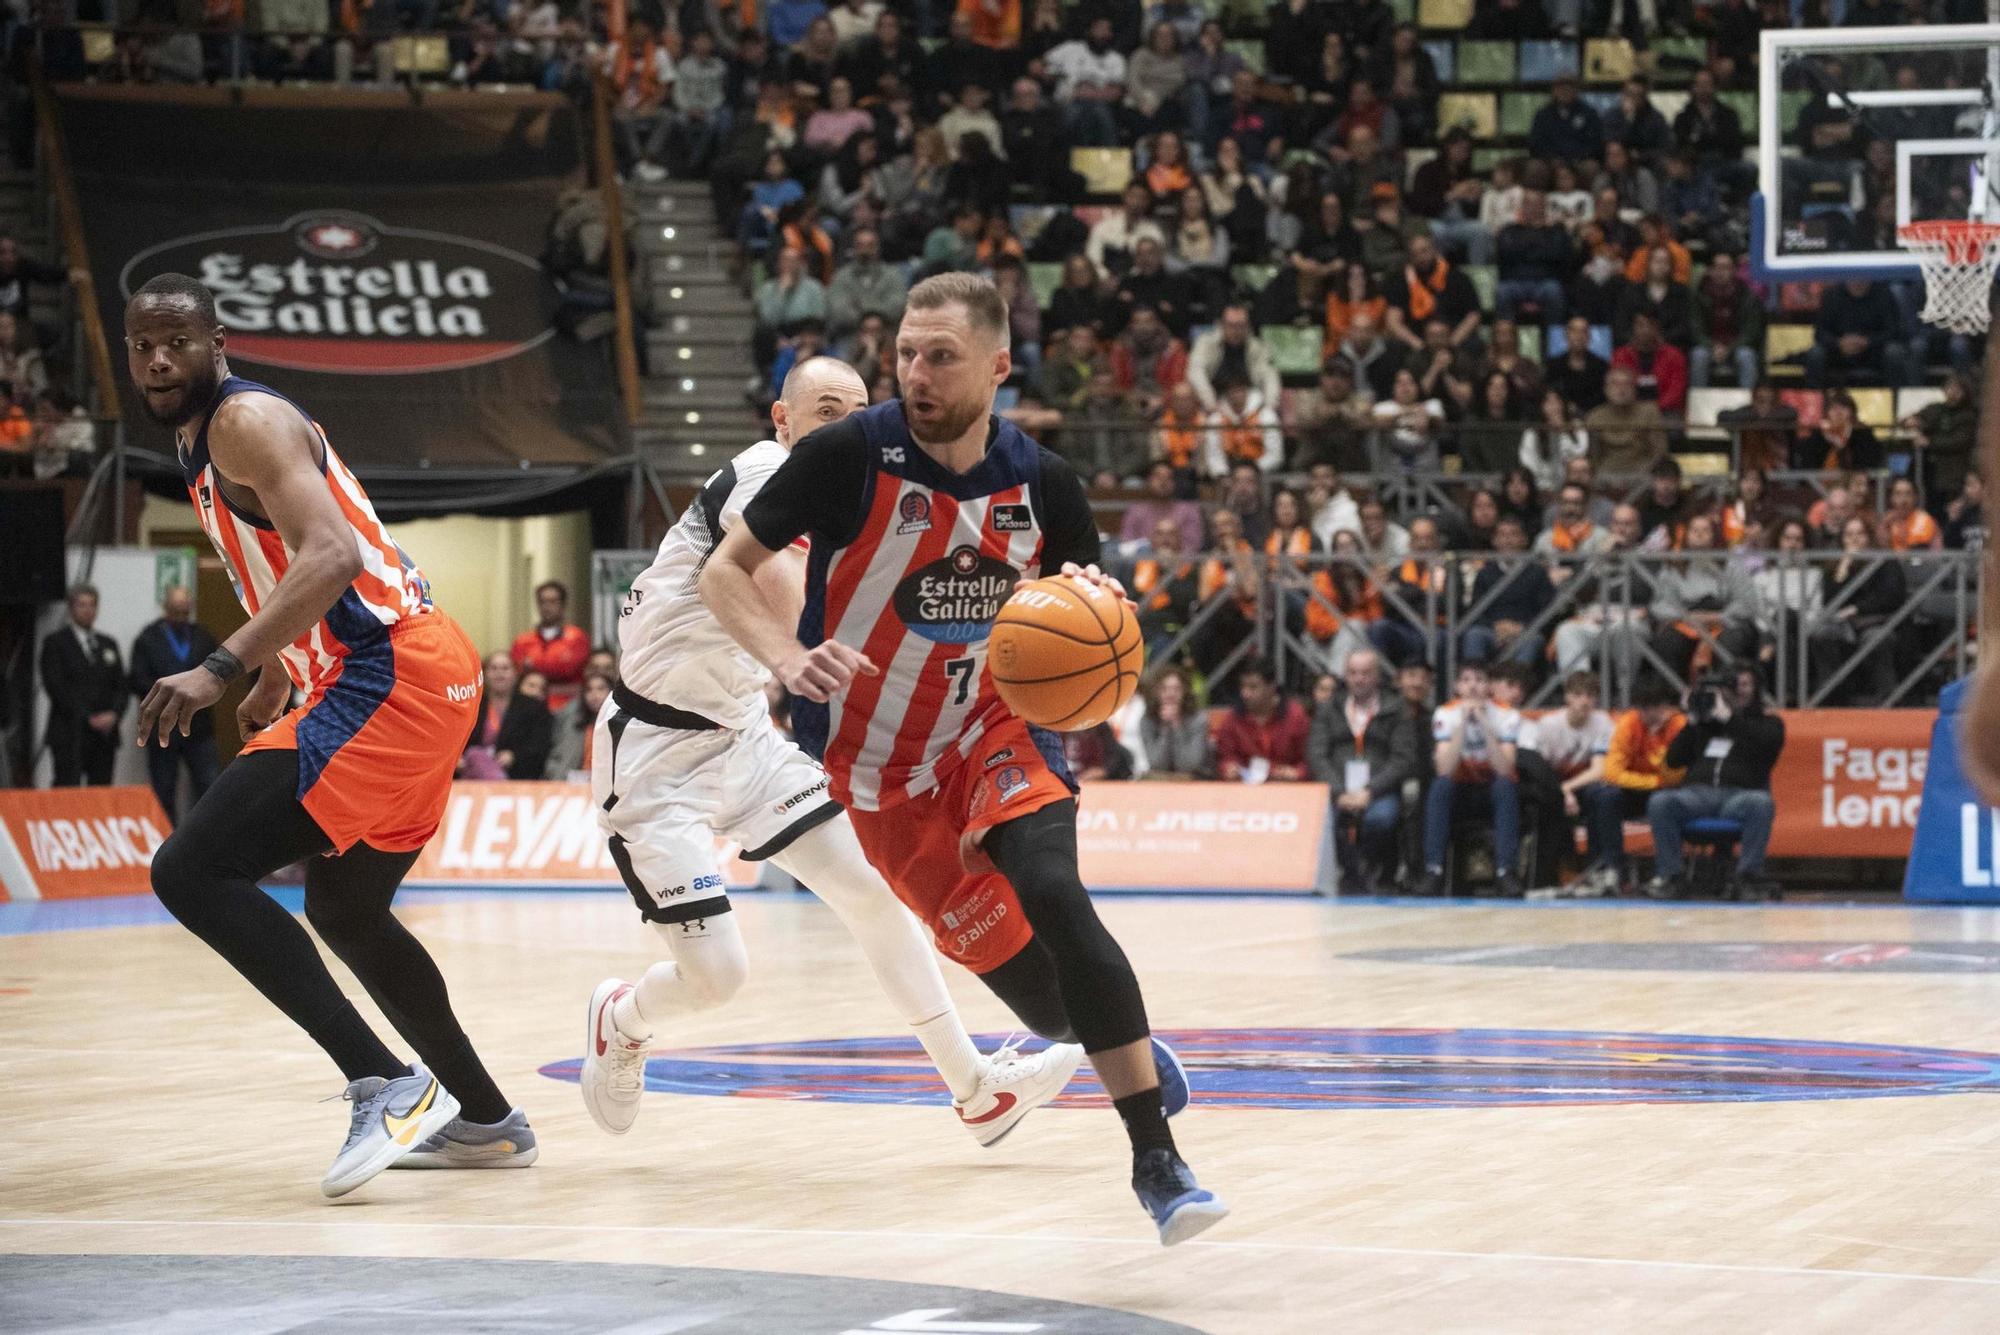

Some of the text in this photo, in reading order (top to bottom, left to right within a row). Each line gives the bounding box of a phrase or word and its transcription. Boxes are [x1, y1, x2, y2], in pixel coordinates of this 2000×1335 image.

[200, 252, 491, 299] Estrella
[213, 294, 486, 336] Galicia
[916, 575, 1008, 599] Estrella
[919, 598, 998, 621] Galicia
[446, 680, 477, 701] Nord
[946, 656, 976, 706] 7
[784, 777, 829, 809] BERNE
[439, 795, 616, 869] LEYM
[657, 885, 685, 899] vive
[950, 902, 1008, 955] galicia
